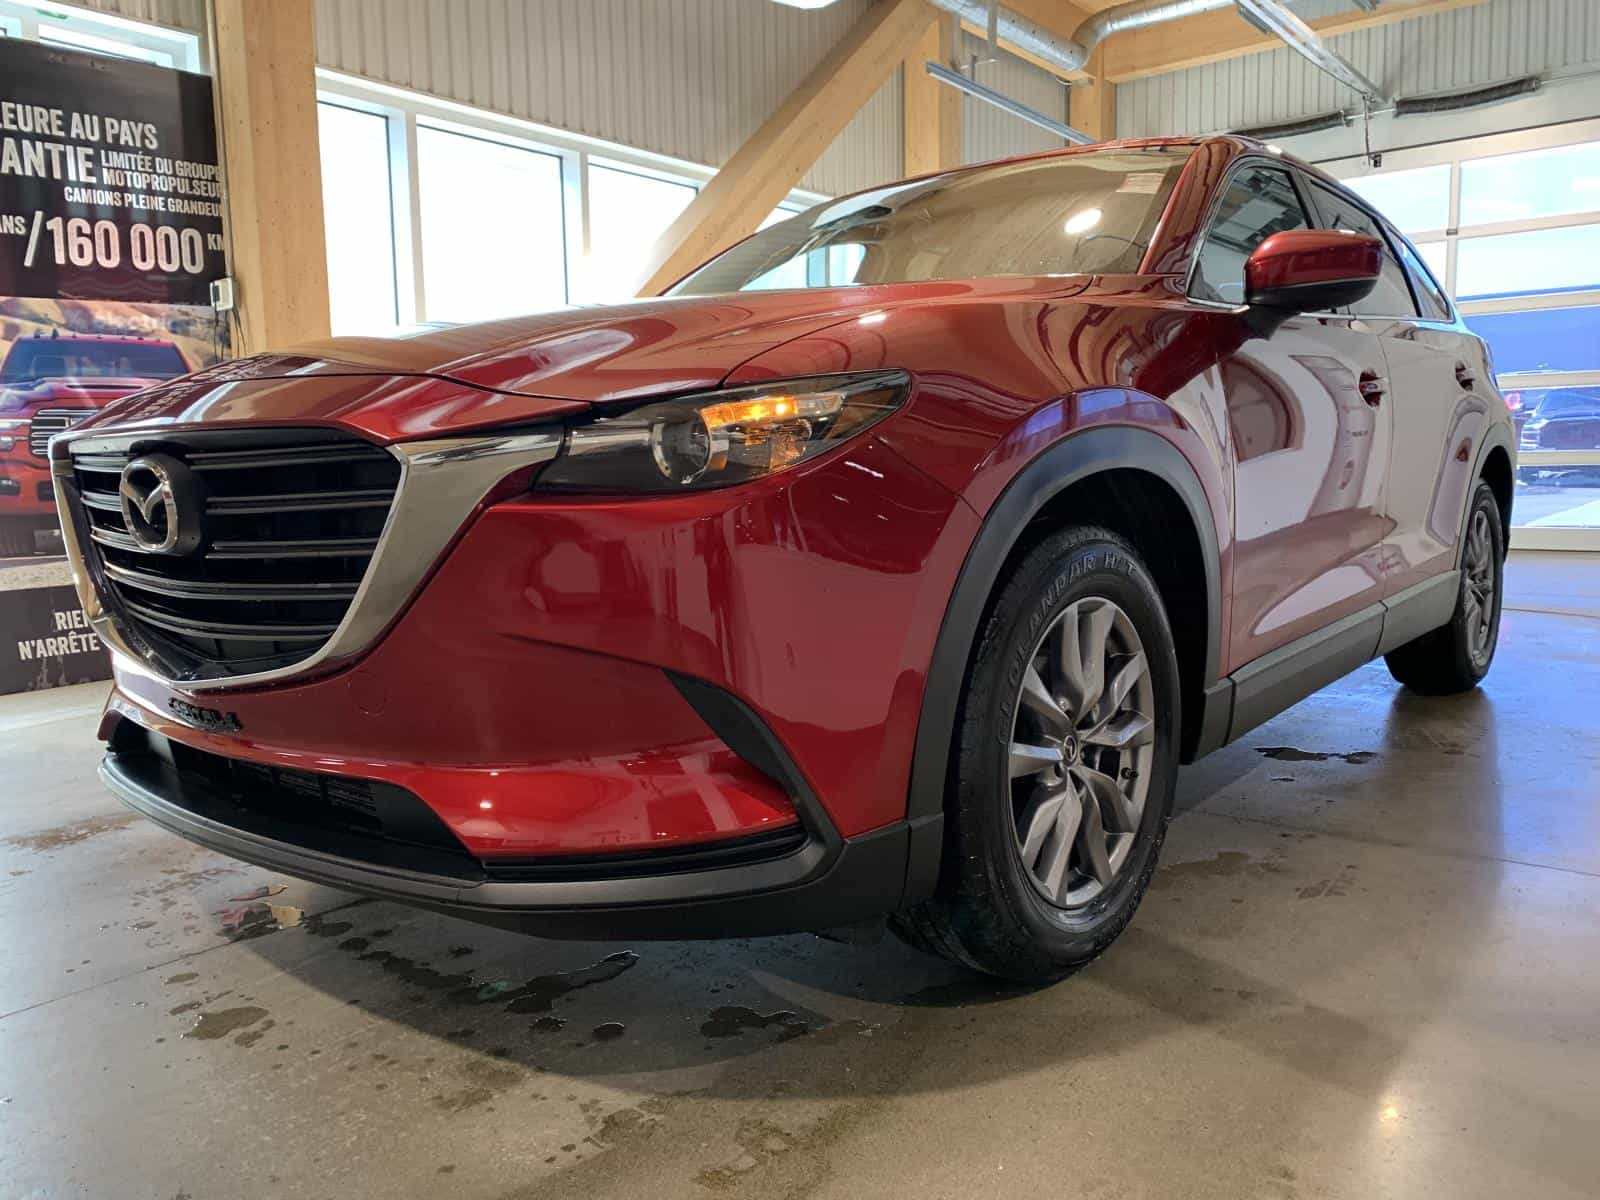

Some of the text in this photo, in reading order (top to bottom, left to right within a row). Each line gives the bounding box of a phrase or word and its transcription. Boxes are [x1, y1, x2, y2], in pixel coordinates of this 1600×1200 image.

[0, 101, 159, 150] EURE AU PAYS
[0, 136, 97, 184] ANTIE
[101, 150, 153, 172] LIMITÉE
[155, 157, 172, 175] DU
[64, 186, 223, 217] CAMIONS PLEINE GRANDEU
[0, 214, 26, 235] NS
[130, 223, 204, 274] 000
[17, 630, 100, 661] N'ARRÊTE
